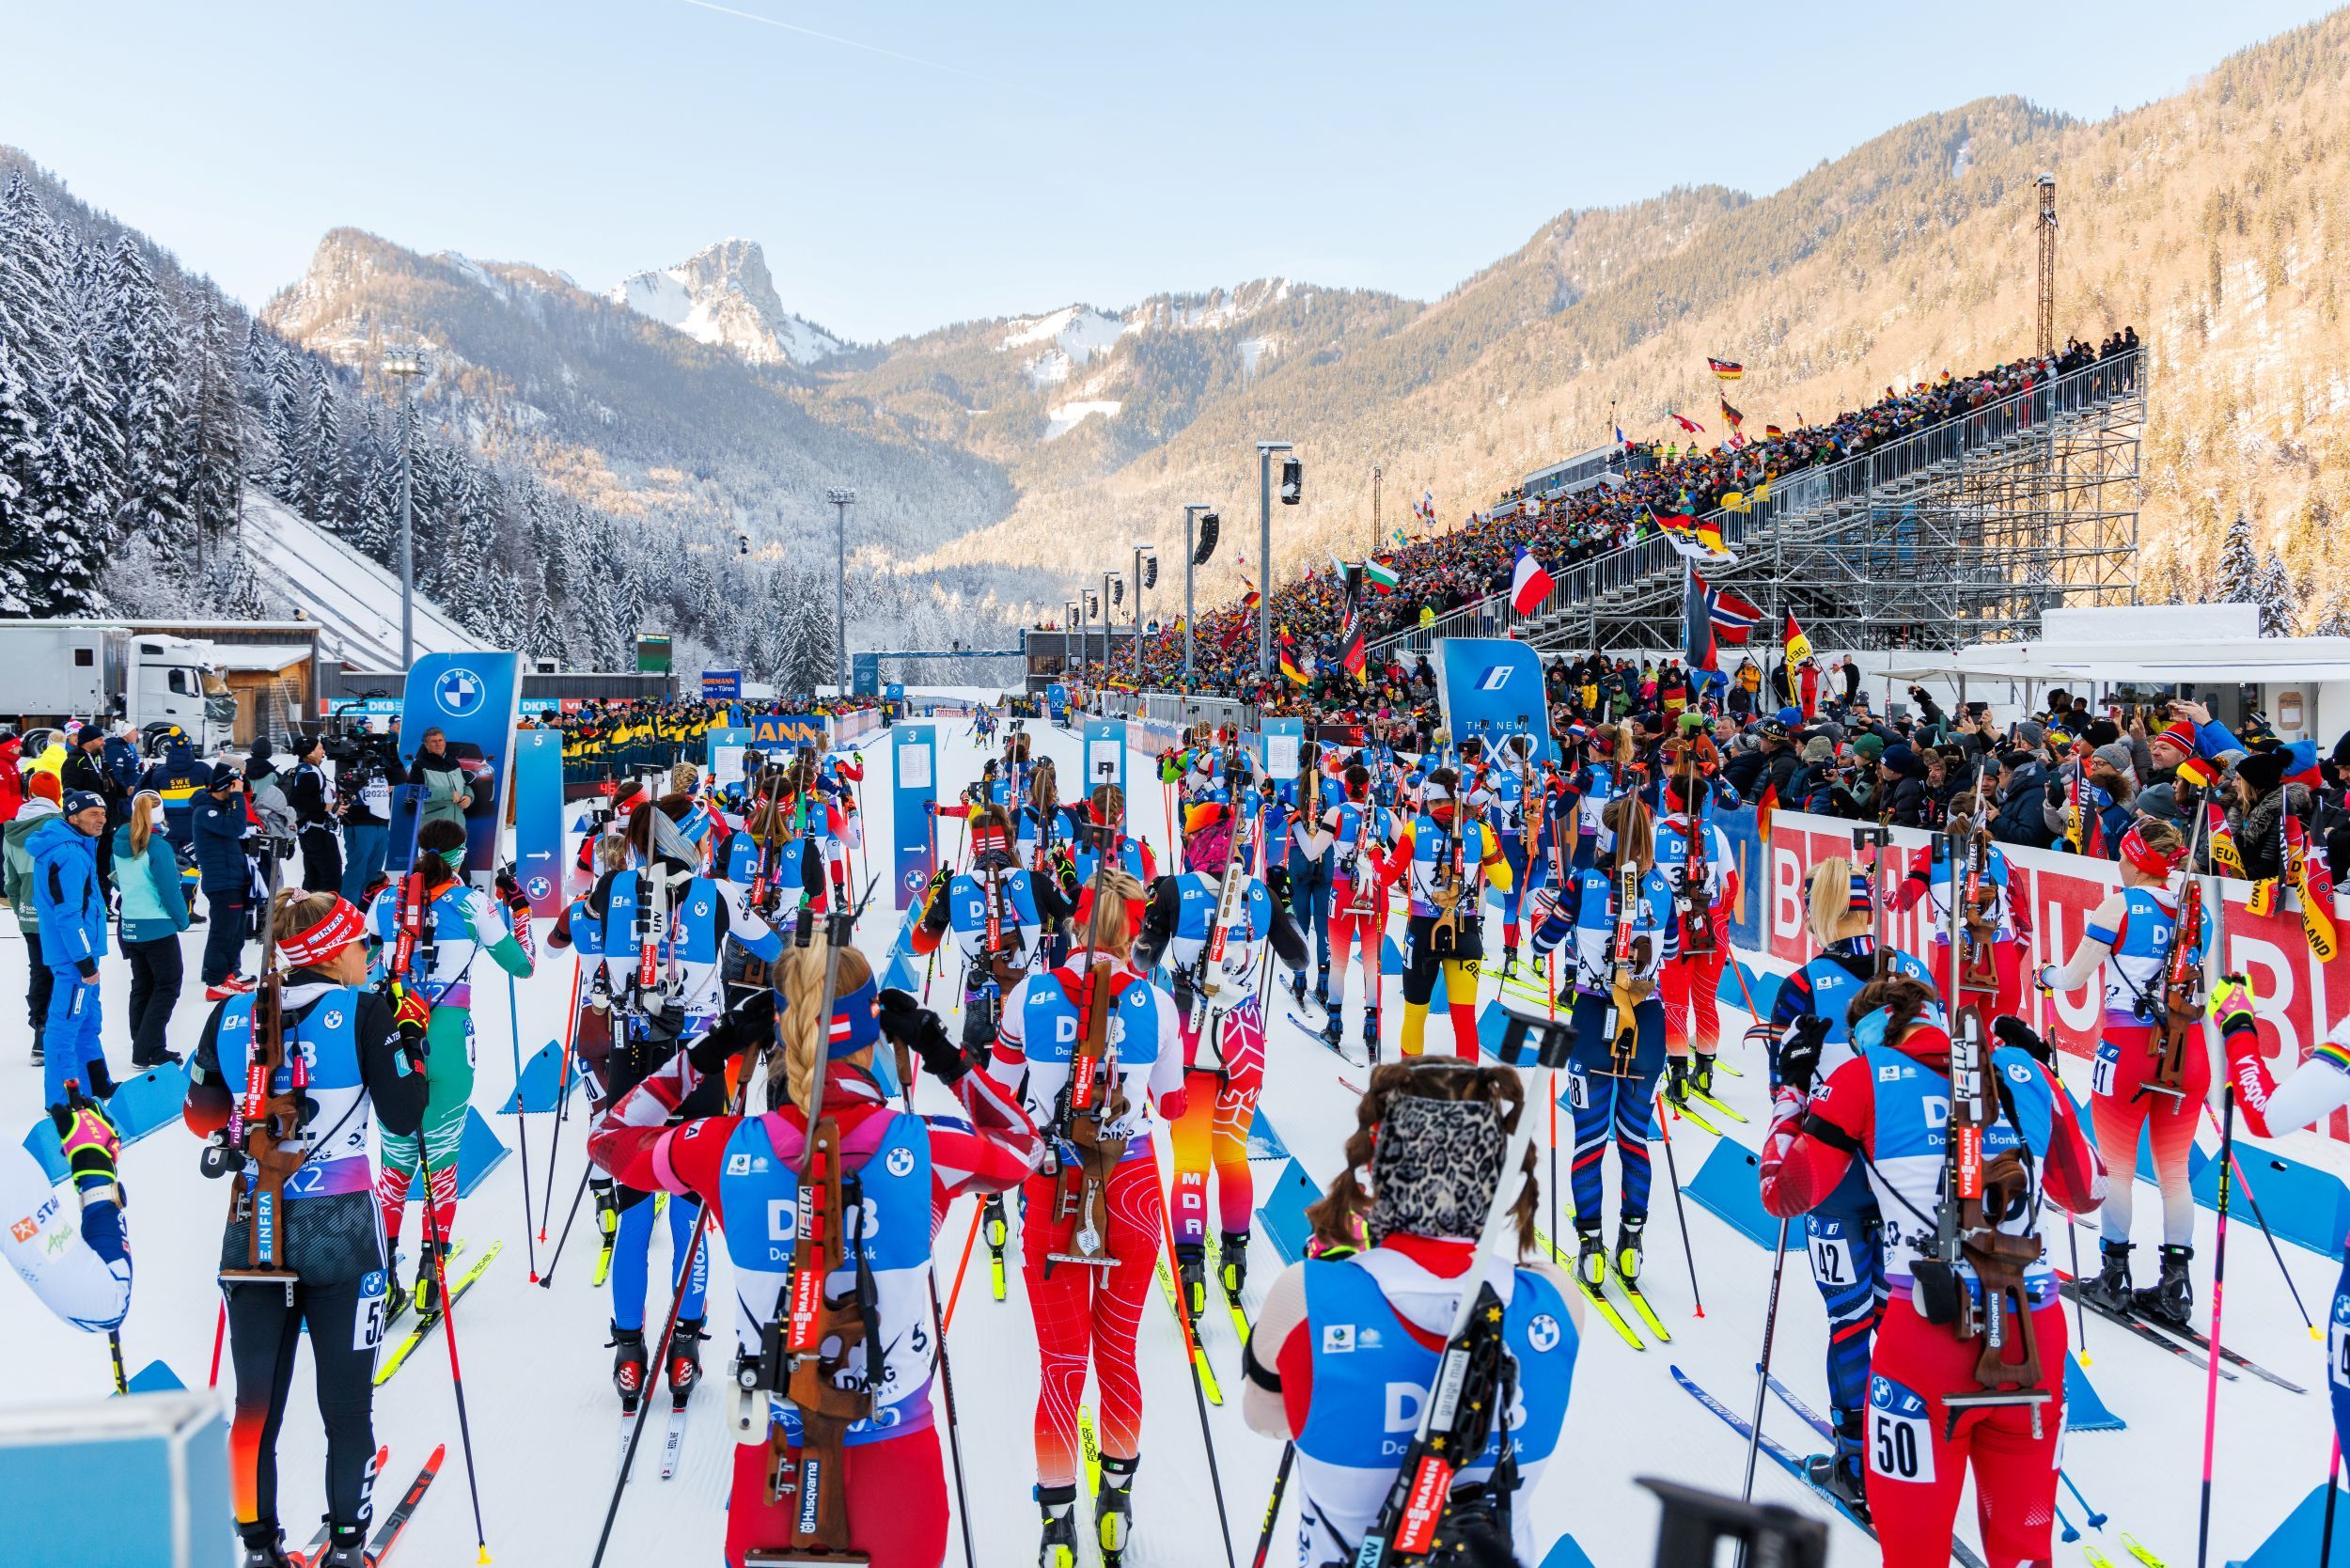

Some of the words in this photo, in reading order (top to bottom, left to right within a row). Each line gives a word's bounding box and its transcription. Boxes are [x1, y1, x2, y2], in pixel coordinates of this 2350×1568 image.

[441, 670, 478, 684] BMW
[369, 701, 394, 712] DKB
[523, 701, 548, 712] DKB
[534, 735, 543, 745] 5
[726, 733, 734, 744] 4
[908, 730, 916, 742] 3
[1102, 726, 1110, 737] 2
[1279, 723, 1286, 734] 1
[170, 777, 190, 786] SWE
[1625, 873, 1637, 909] somfy
[1967, 873, 1978, 902] VIESSMANN
[653, 911, 662, 933] LHV
[970, 898, 1012, 918] DB
[1213, 927, 1223, 961] VIESSMANN
[1618, 923, 1627, 957] VIESSMANN
[644, 945, 652, 983] VIESSMANN
[2172, 945, 2186, 980] VIESSMANN
[401, 999, 415, 1017] LEKI
[1056, 1016, 1126, 1043] DB
[1074, 1056, 1089, 1105] VIESSMANN
[1954, 1039, 1968, 1101] HELLA
[2092, 1059, 2107, 1092] 41
[248, 1066, 260, 1117] VIESSMANN
[81, 1111, 102, 1139] LEKI
[1928, 1135, 1946, 1146] Da
[1990, 1133, 2019, 1145] Bank
[1961, 1128, 1976, 1196] VIESSMANN
[767, 1198, 879, 1241] DB
[800, 1187, 813, 1238] HELLA
[689, 1219, 707, 1295] ETONIA
[769, 1247, 790, 1261] Da
[1818, 1242, 1845, 1283] 42
[794, 1271, 812, 1347] VIESSMANN
[1990, 1292, 1999, 1338] Husqvarna
[1441, 1382, 1457, 1418] garage
[1449, 1351, 1465, 1380] mark
[1385, 1382, 1528, 1434] DB
[1081, 1427, 1099, 1464] FISCHER
[1382, 1440, 1407, 1457] Da
[1876, 1415, 1919, 1479] 50
[802, 1461, 819, 1523] Husqvarna
[1402, 1459, 1440, 1549] VIESSMANN
[1799, 1470, 1838, 1507] SALOMON
